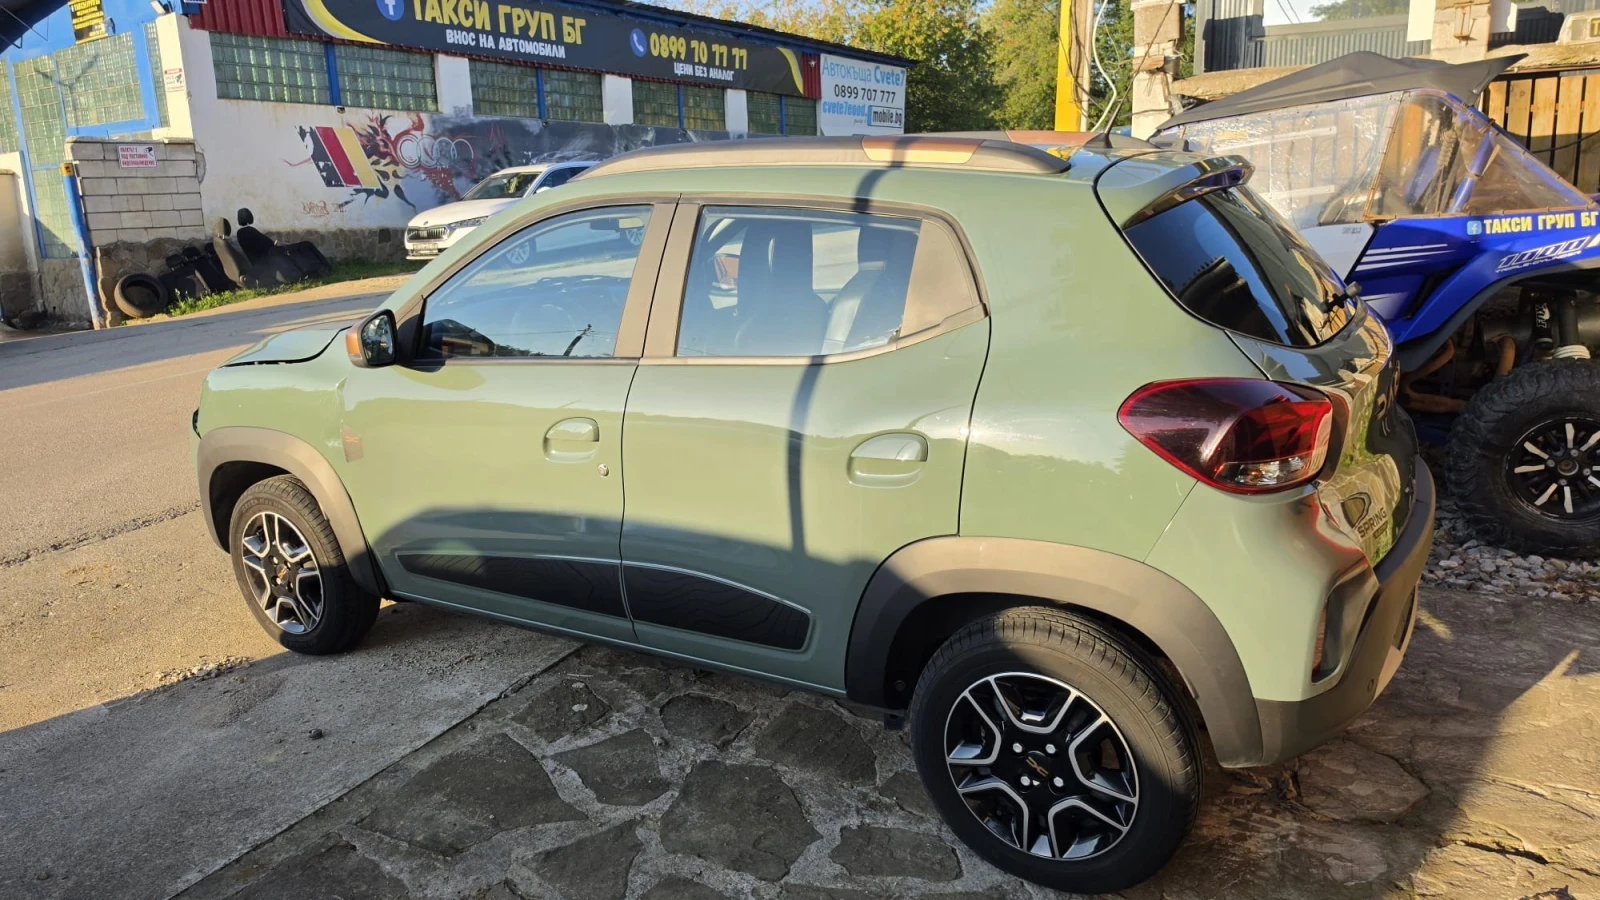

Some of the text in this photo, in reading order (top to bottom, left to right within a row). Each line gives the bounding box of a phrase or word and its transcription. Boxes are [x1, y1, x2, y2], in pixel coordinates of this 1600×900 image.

[413, 0, 586, 45] ТАКСИ ГРУП БГ
[446, 29, 566, 59] ВНОС НА АВТОМОБИЛИ
[650, 32, 747, 70] 0899 70 77 77
[674, 62, 734, 81] ЦЕНИ БЕЗ АНАЛОГ
[874, 65, 906, 87] Cvete7
[834, 84, 896, 104] 0899 707 777
[873, 109, 902, 126] mobile.bg
[1484, 211, 1599, 234] ТАКСИ ГРУП БГ
[1357, 507, 1387, 539] SPRING
